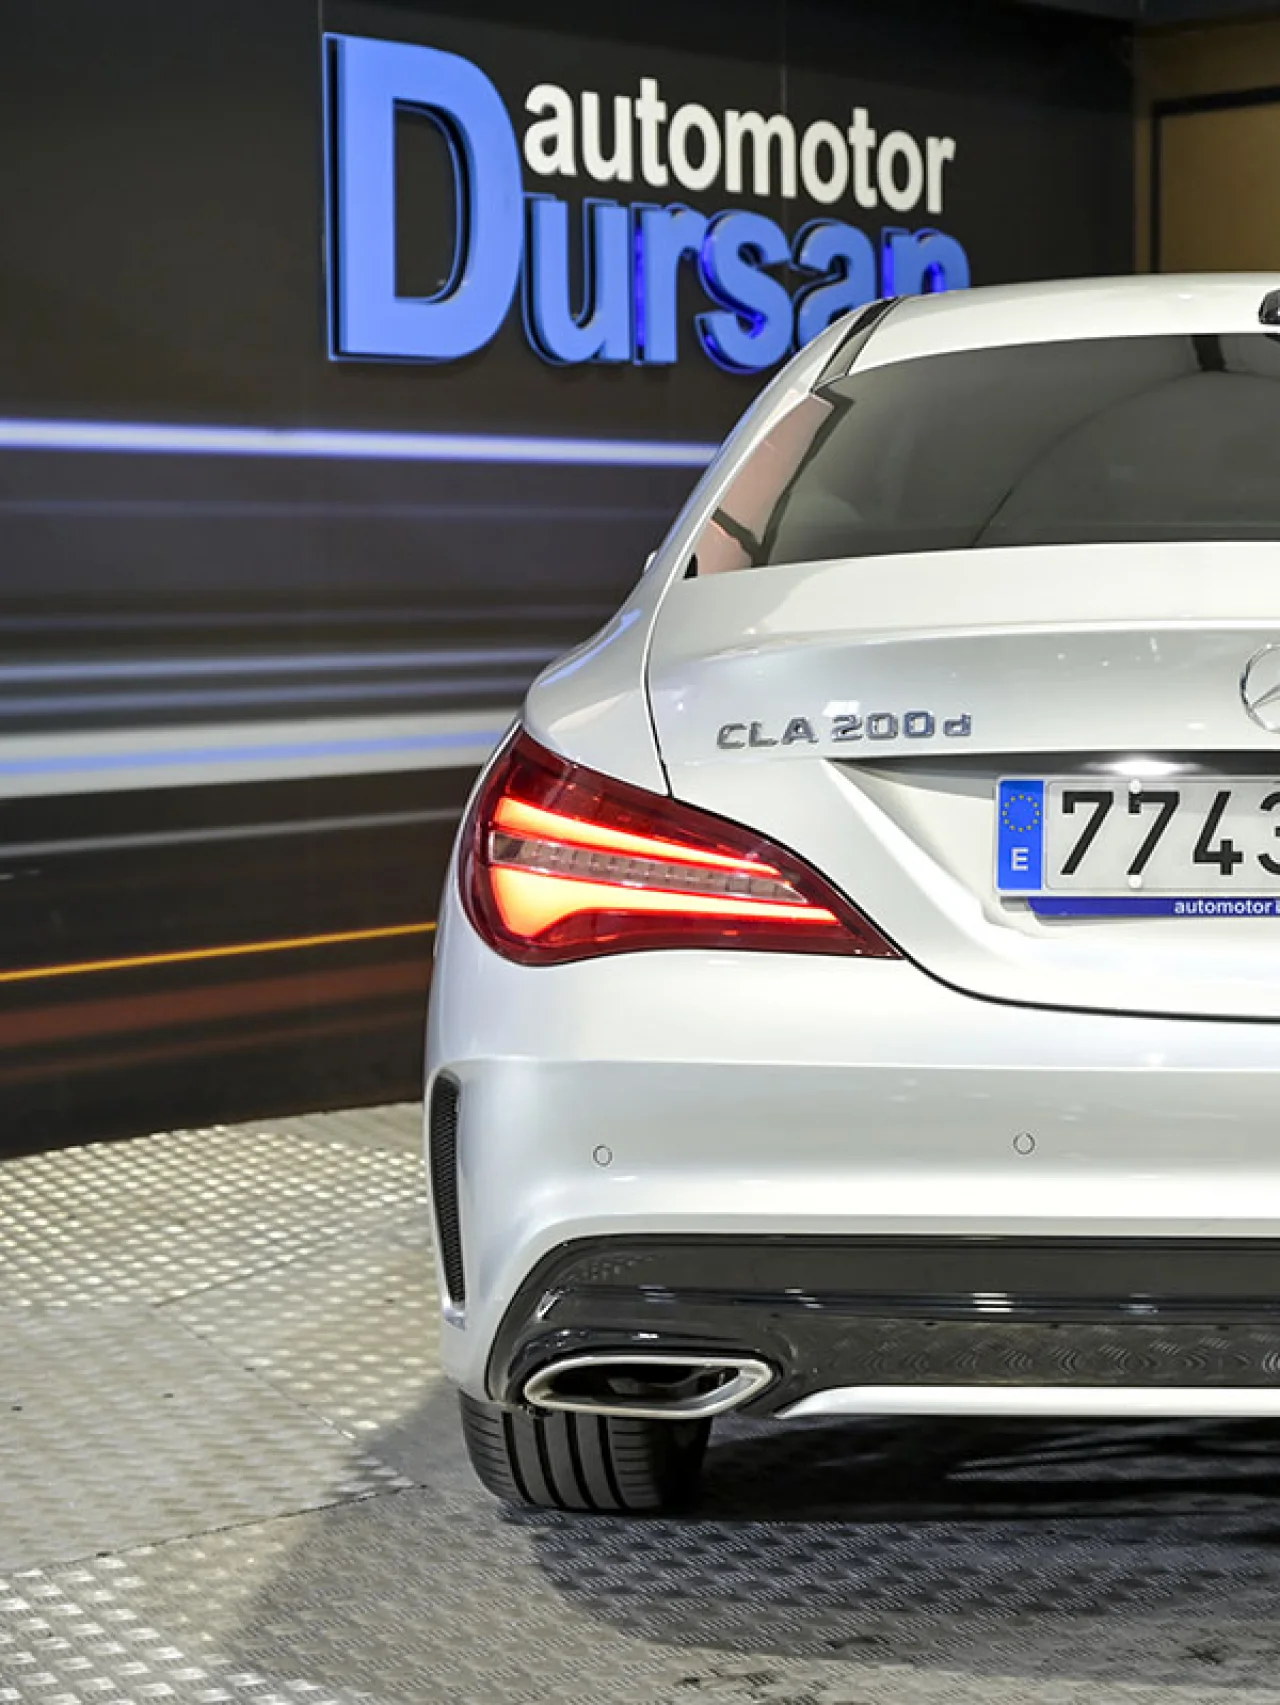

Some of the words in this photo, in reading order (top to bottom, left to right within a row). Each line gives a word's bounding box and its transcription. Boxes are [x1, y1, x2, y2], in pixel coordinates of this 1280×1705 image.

[524, 78, 956, 213] automotor
[716, 716, 818, 749] CLA
[1011, 848, 1029, 871] E
